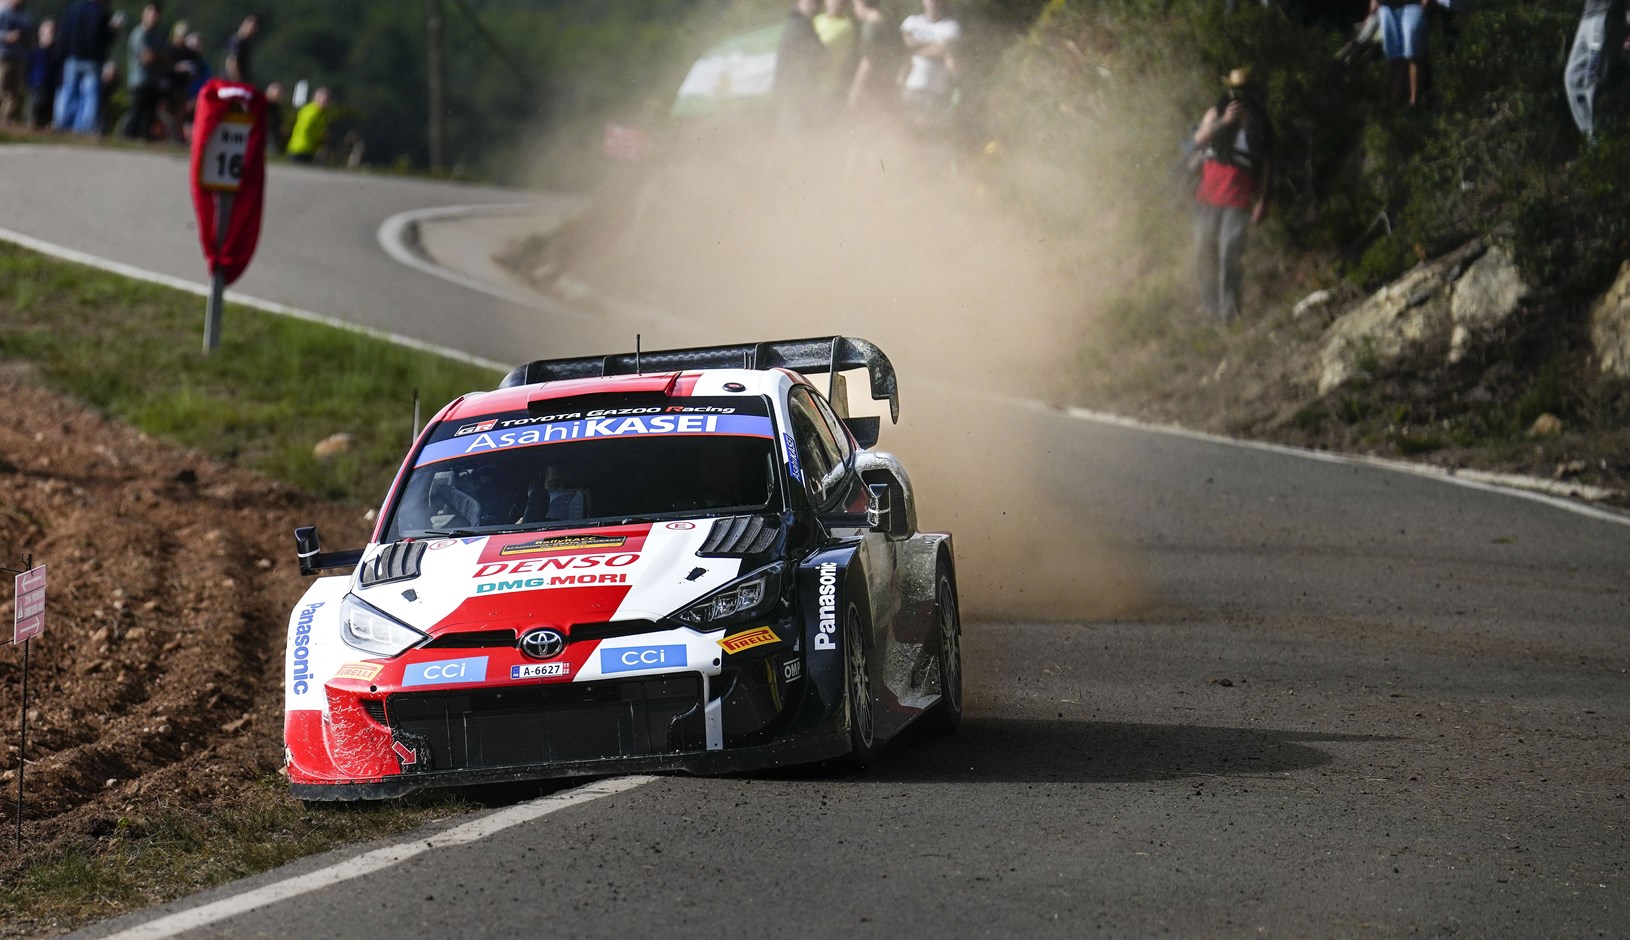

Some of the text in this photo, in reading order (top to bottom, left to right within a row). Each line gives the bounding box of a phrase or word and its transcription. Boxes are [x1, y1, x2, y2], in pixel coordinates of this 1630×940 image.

[221, 126, 246, 144] km
[216, 152, 243, 180] 16
[457, 405, 736, 436] GR TOYOTA GAZOO Racing
[472, 554, 641, 578] DENSO
[814, 562, 838, 651] Panasonic
[293, 602, 326, 695] Panasonic
[722, 629, 775, 651] PIRELLI
[335, 664, 377, 678] PIRELLI
[523, 665, 561, 676] A-6627
[784, 661, 801, 679] OMP
